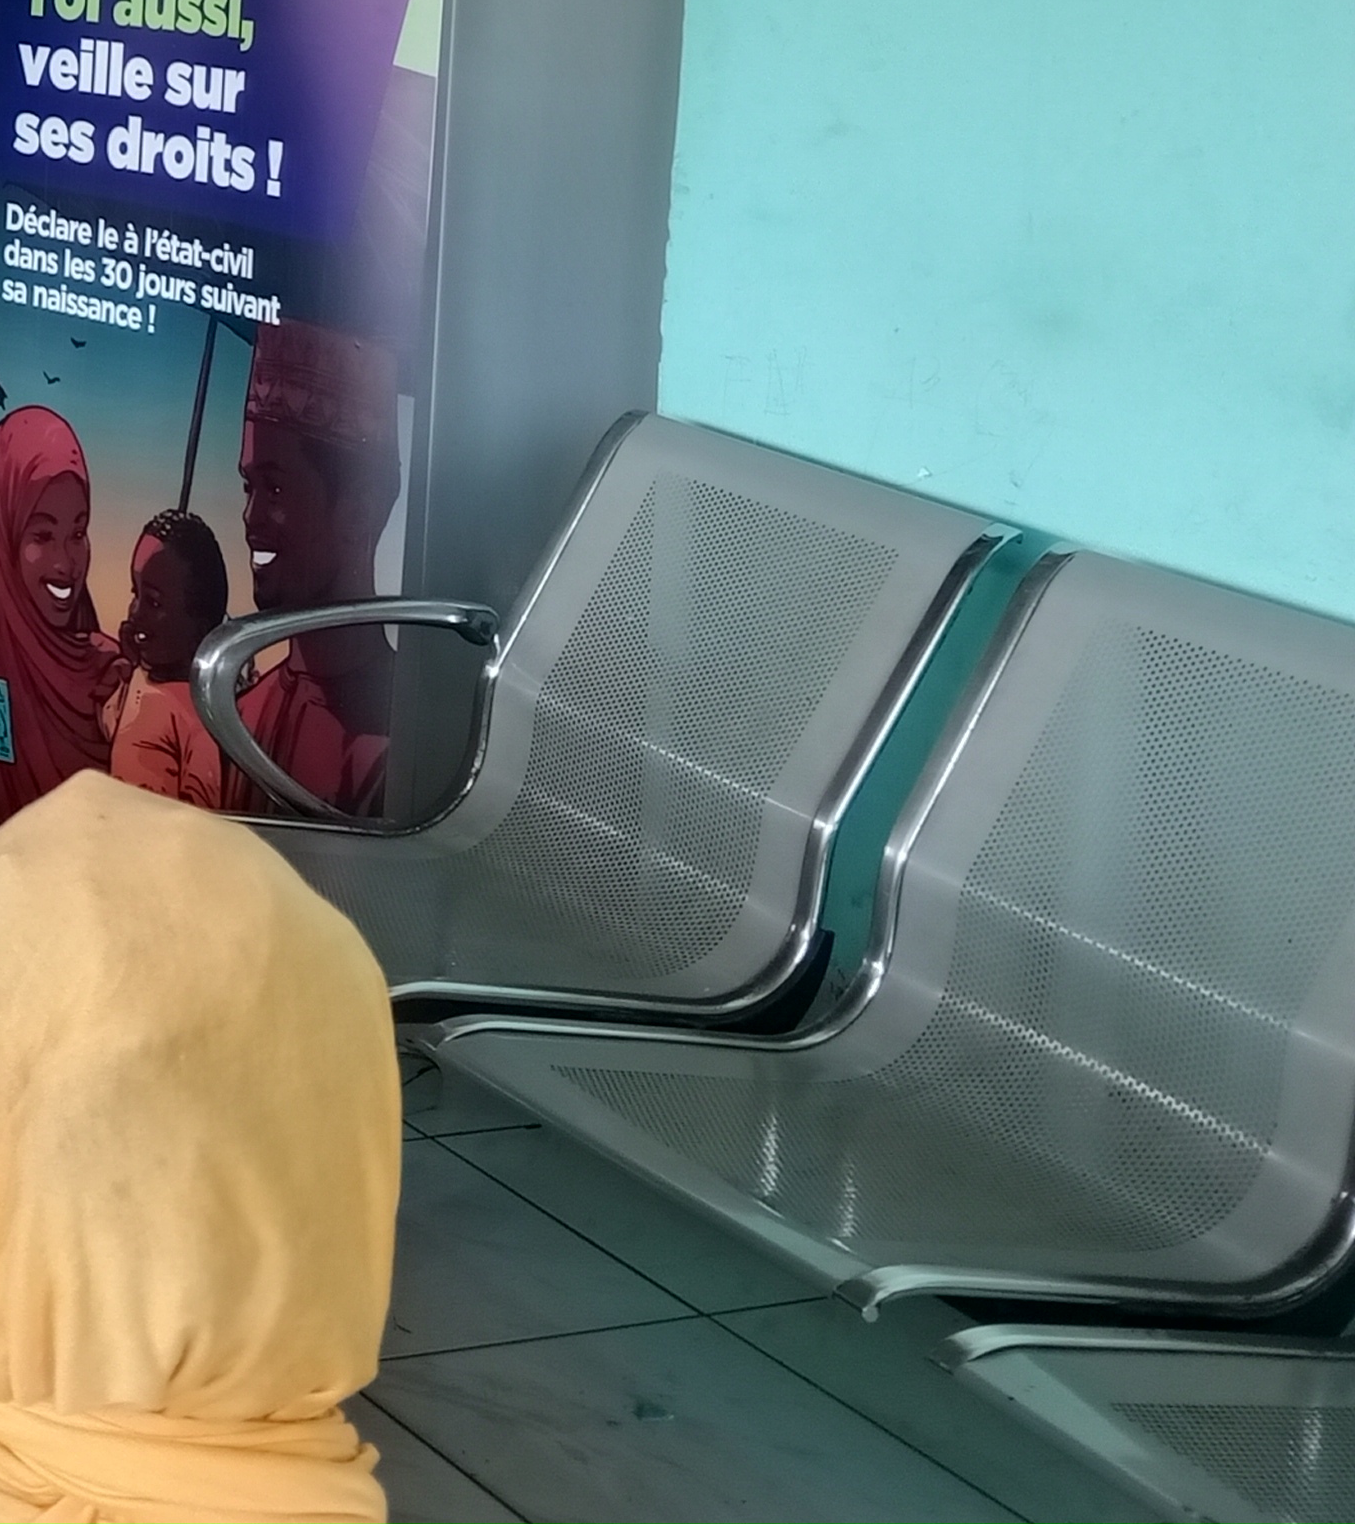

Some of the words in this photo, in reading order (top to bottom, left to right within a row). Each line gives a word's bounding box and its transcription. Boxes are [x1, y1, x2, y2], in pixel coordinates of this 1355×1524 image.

[18, 37, 154, 101] veille
[164, 61, 245, 113] sur
[13, 112, 95, 163] ses
[106, 115, 256, 192] droits
[5, 202, 92, 245] Déclare
[97, 218, 119, 250] le
[123, 223, 139, 255] à
[2, 279, 28, 304] sa
[32, 284, 142, 331] naissance
[4, 239, 59, 275] dans
[64, 249, 95, 283] les
[100, 257, 133, 290] 30
[136, 264, 196, 305] jours
[201, 282, 281, 326] suivant
